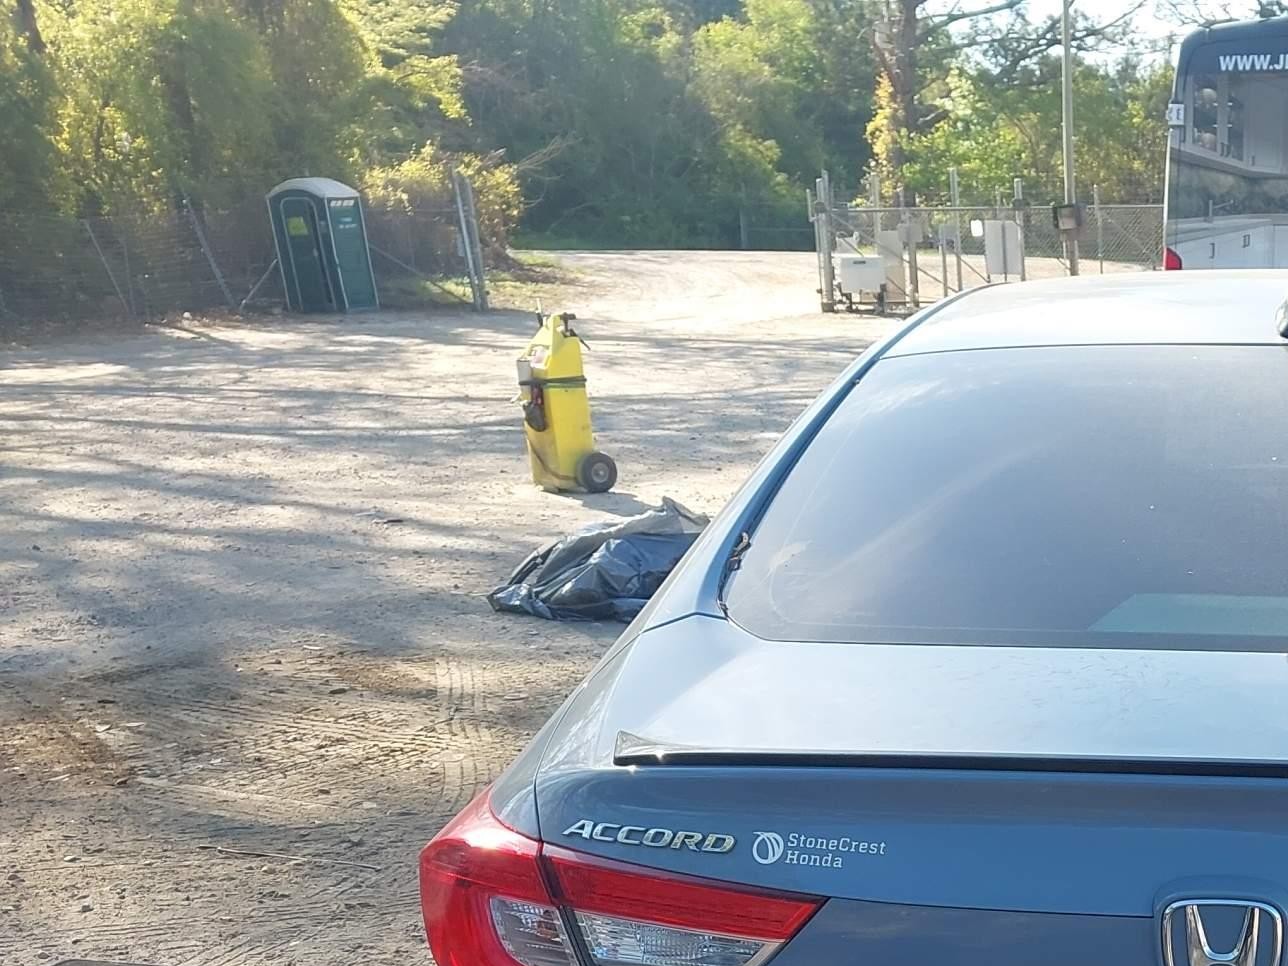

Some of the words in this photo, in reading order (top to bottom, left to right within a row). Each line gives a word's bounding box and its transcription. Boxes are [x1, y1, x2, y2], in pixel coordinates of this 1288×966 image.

[562, 819, 736, 853] ACCORD
[786, 833, 886, 856] StoneCrest
[784, 849, 844, 869] Honda
